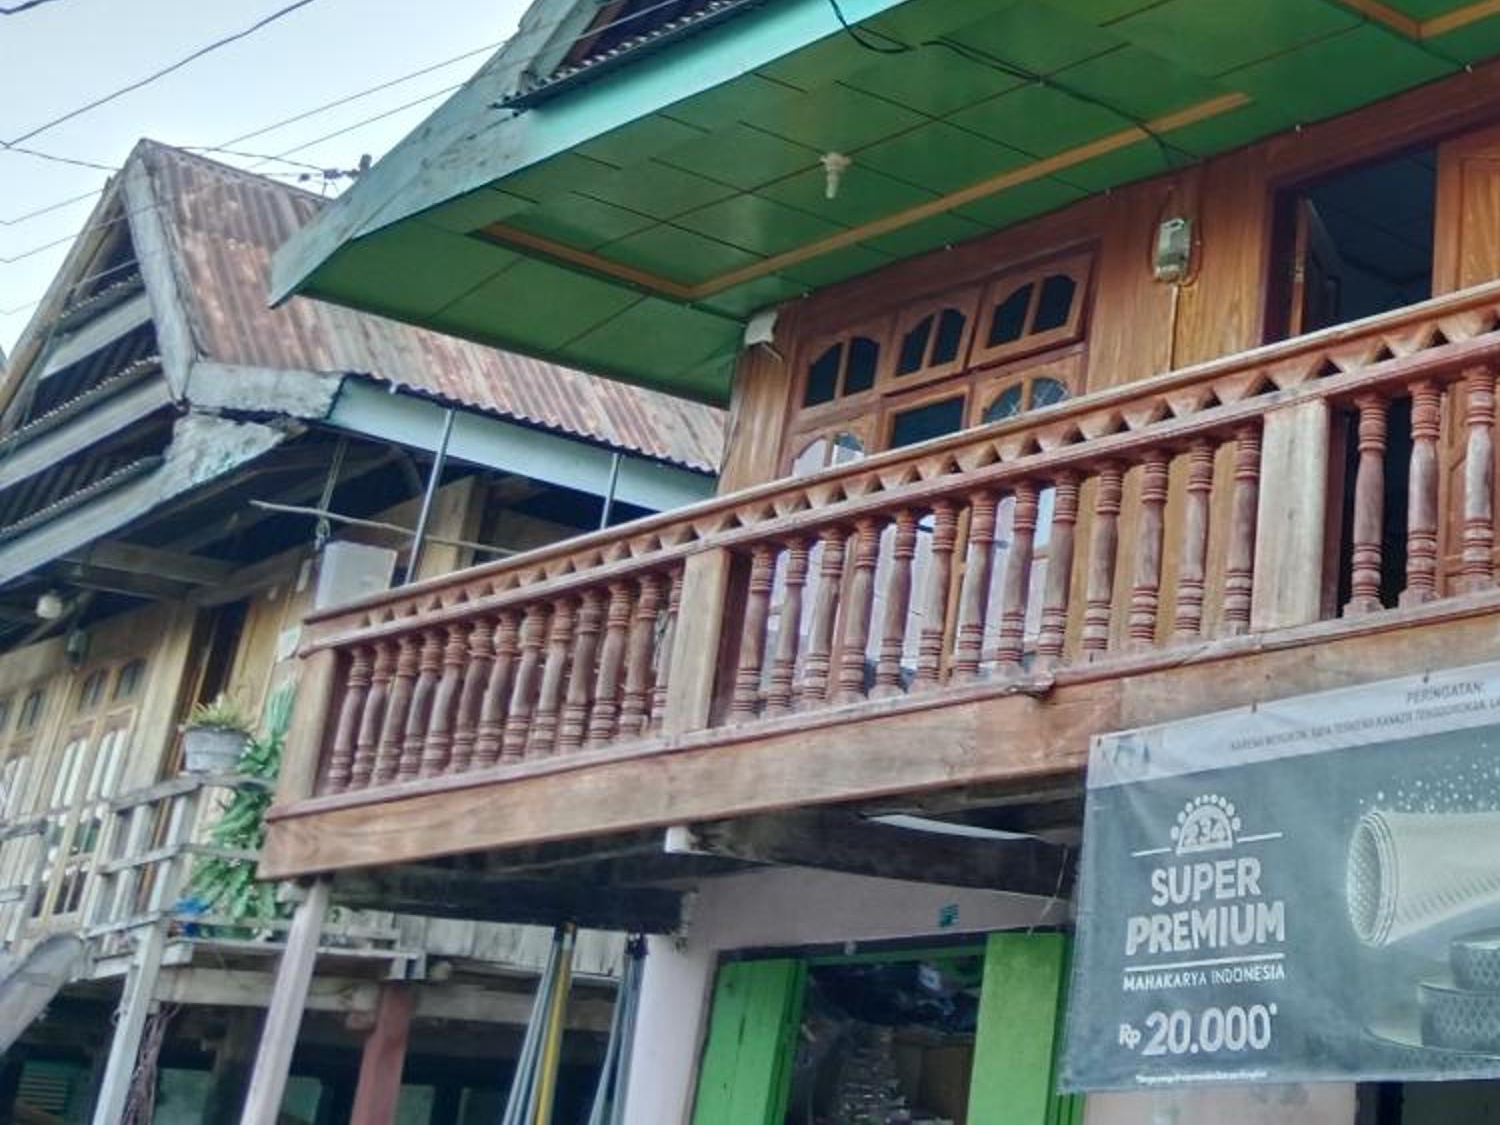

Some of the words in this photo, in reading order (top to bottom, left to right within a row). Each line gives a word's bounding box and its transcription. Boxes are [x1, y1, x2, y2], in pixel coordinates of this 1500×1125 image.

[1151, 857, 1261, 907] SUPER
[1125, 901, 1286, 956] PREMIUM
[1123, 972, 1207, 991] MAHAKARYA
[1211, 963, 1285, 985] INDONESIA
[1119, 1024, 1142, 1049] Rp
